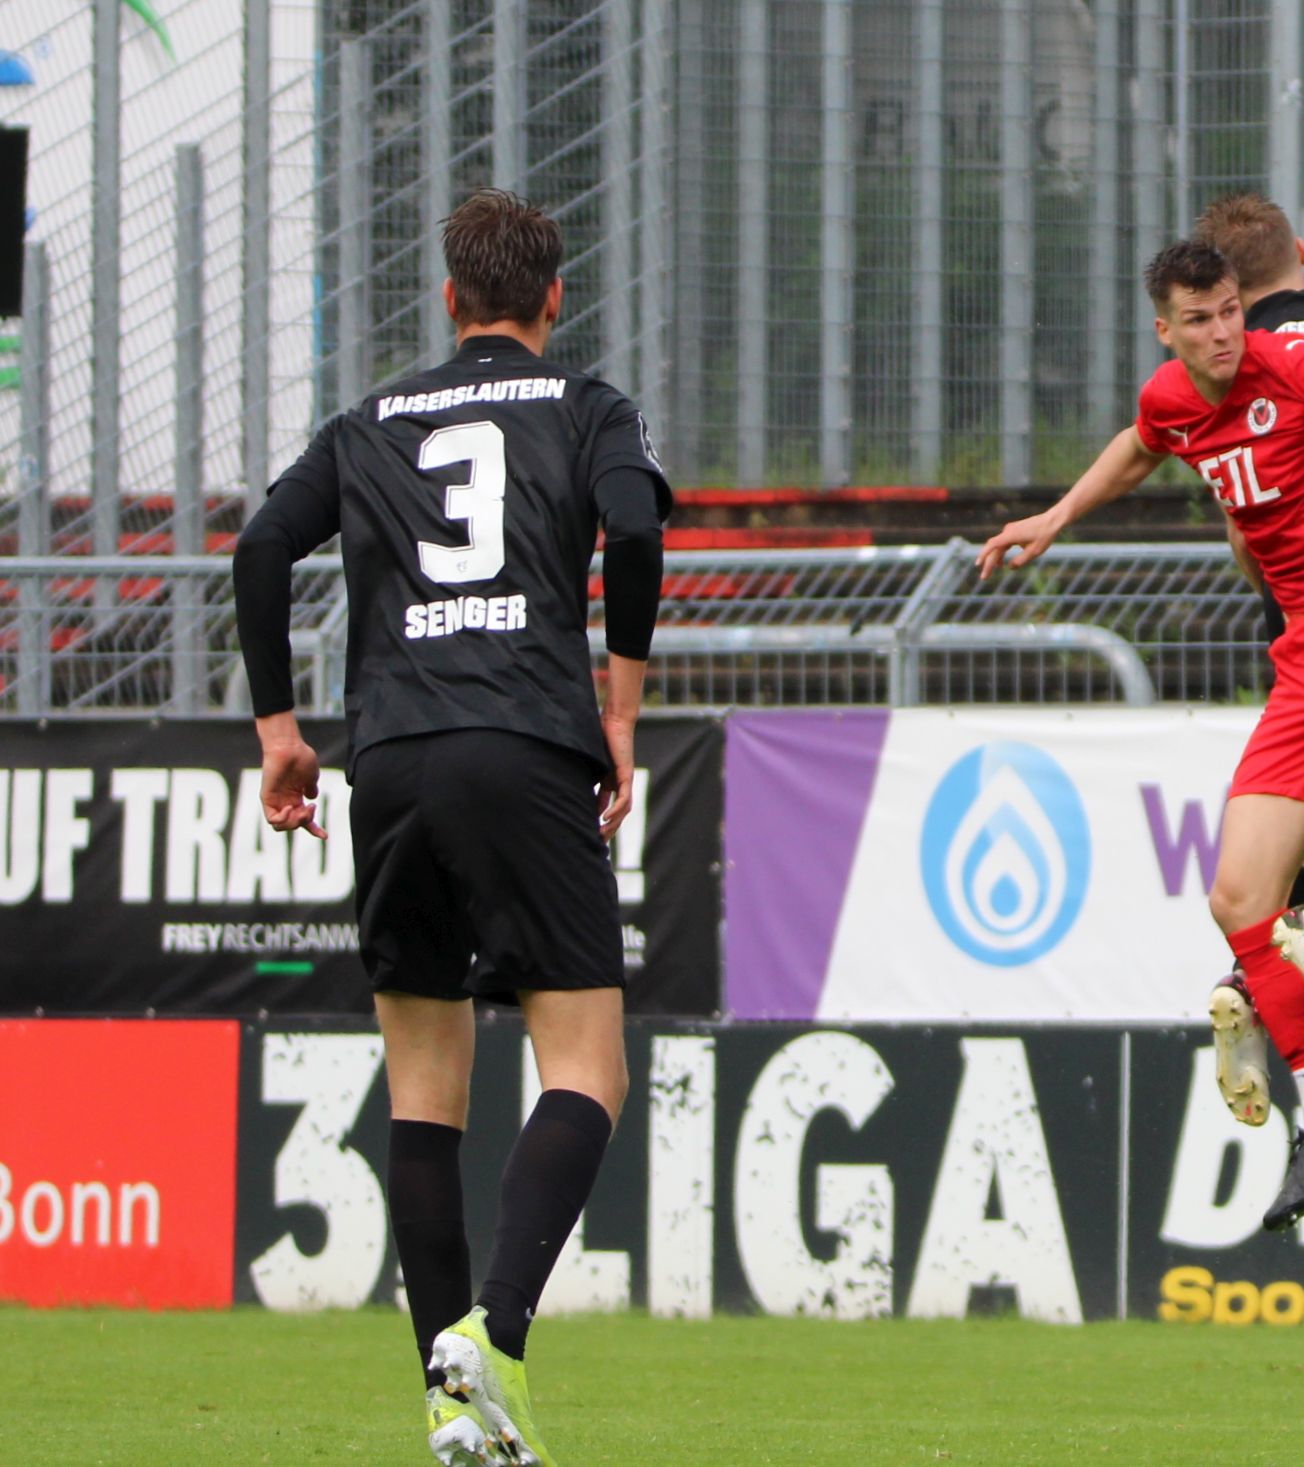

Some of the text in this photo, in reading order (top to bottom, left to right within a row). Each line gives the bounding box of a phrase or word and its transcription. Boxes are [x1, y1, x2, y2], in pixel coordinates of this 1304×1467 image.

[378, 378, 567, 422] KAISERSLAUTERN
[417, 420, 507, 584] 3
[1198, 446, 1281, 507] ETL
[405, 594, 527, 639] SENGER
